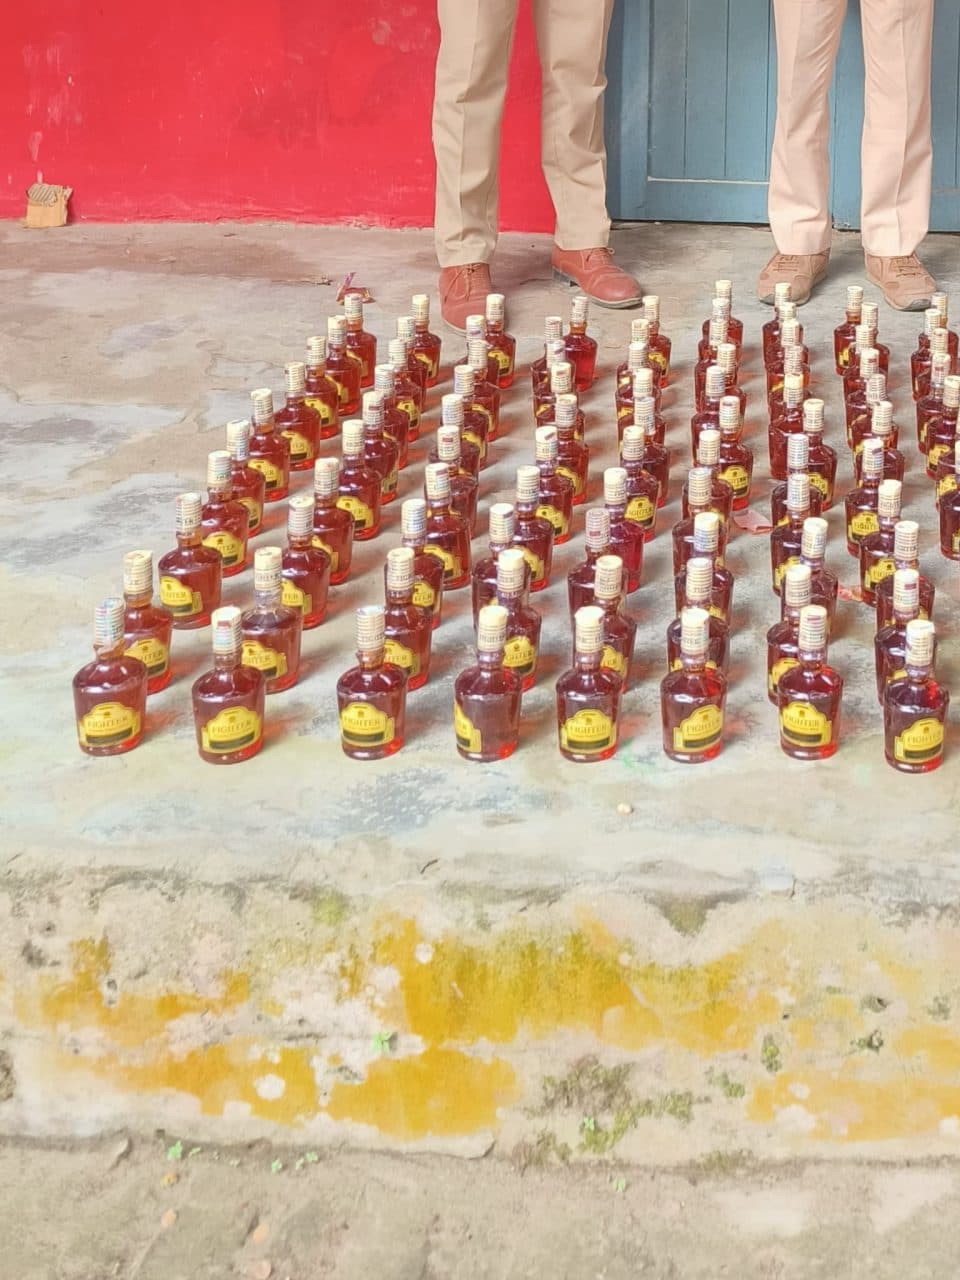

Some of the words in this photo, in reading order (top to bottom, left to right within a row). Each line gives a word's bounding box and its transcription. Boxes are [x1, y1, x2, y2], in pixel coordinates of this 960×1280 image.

[87, 716, 129, 729] FIGHTER
[211, 720, 252, 733] FIGHTER
[343, 717, 381, 728] FIGHTER
[784, 715, 821, 728] FIGHTER
[566, 724, 608, 734] FIGHTER
